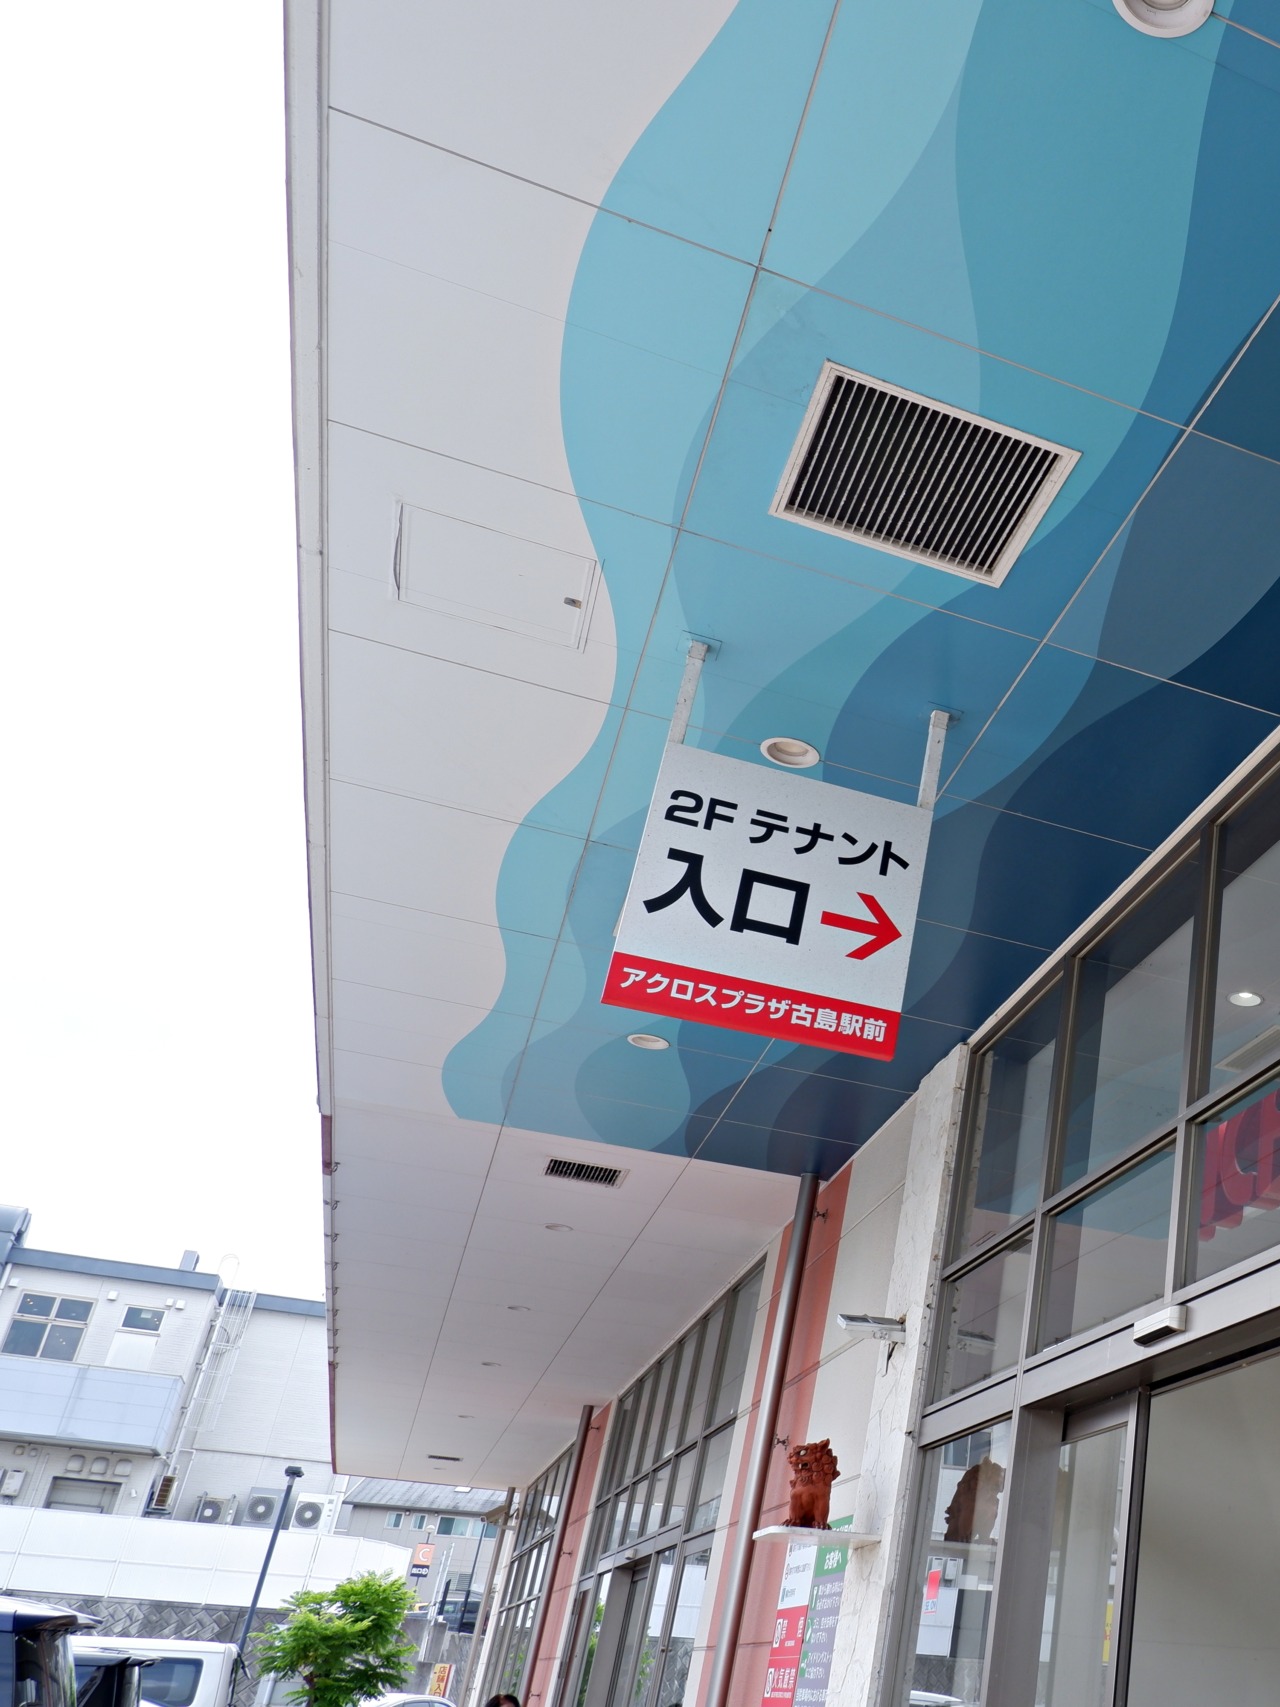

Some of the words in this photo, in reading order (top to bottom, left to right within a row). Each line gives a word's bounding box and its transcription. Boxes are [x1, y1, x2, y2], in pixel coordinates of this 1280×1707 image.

[664, 788, 739, 831] 2F
[749, 808, 910, 877] テナント
[643, 846, 812, 946] 入口
[618, 966, 888, 1043] アクロスプラザ古島駅前
